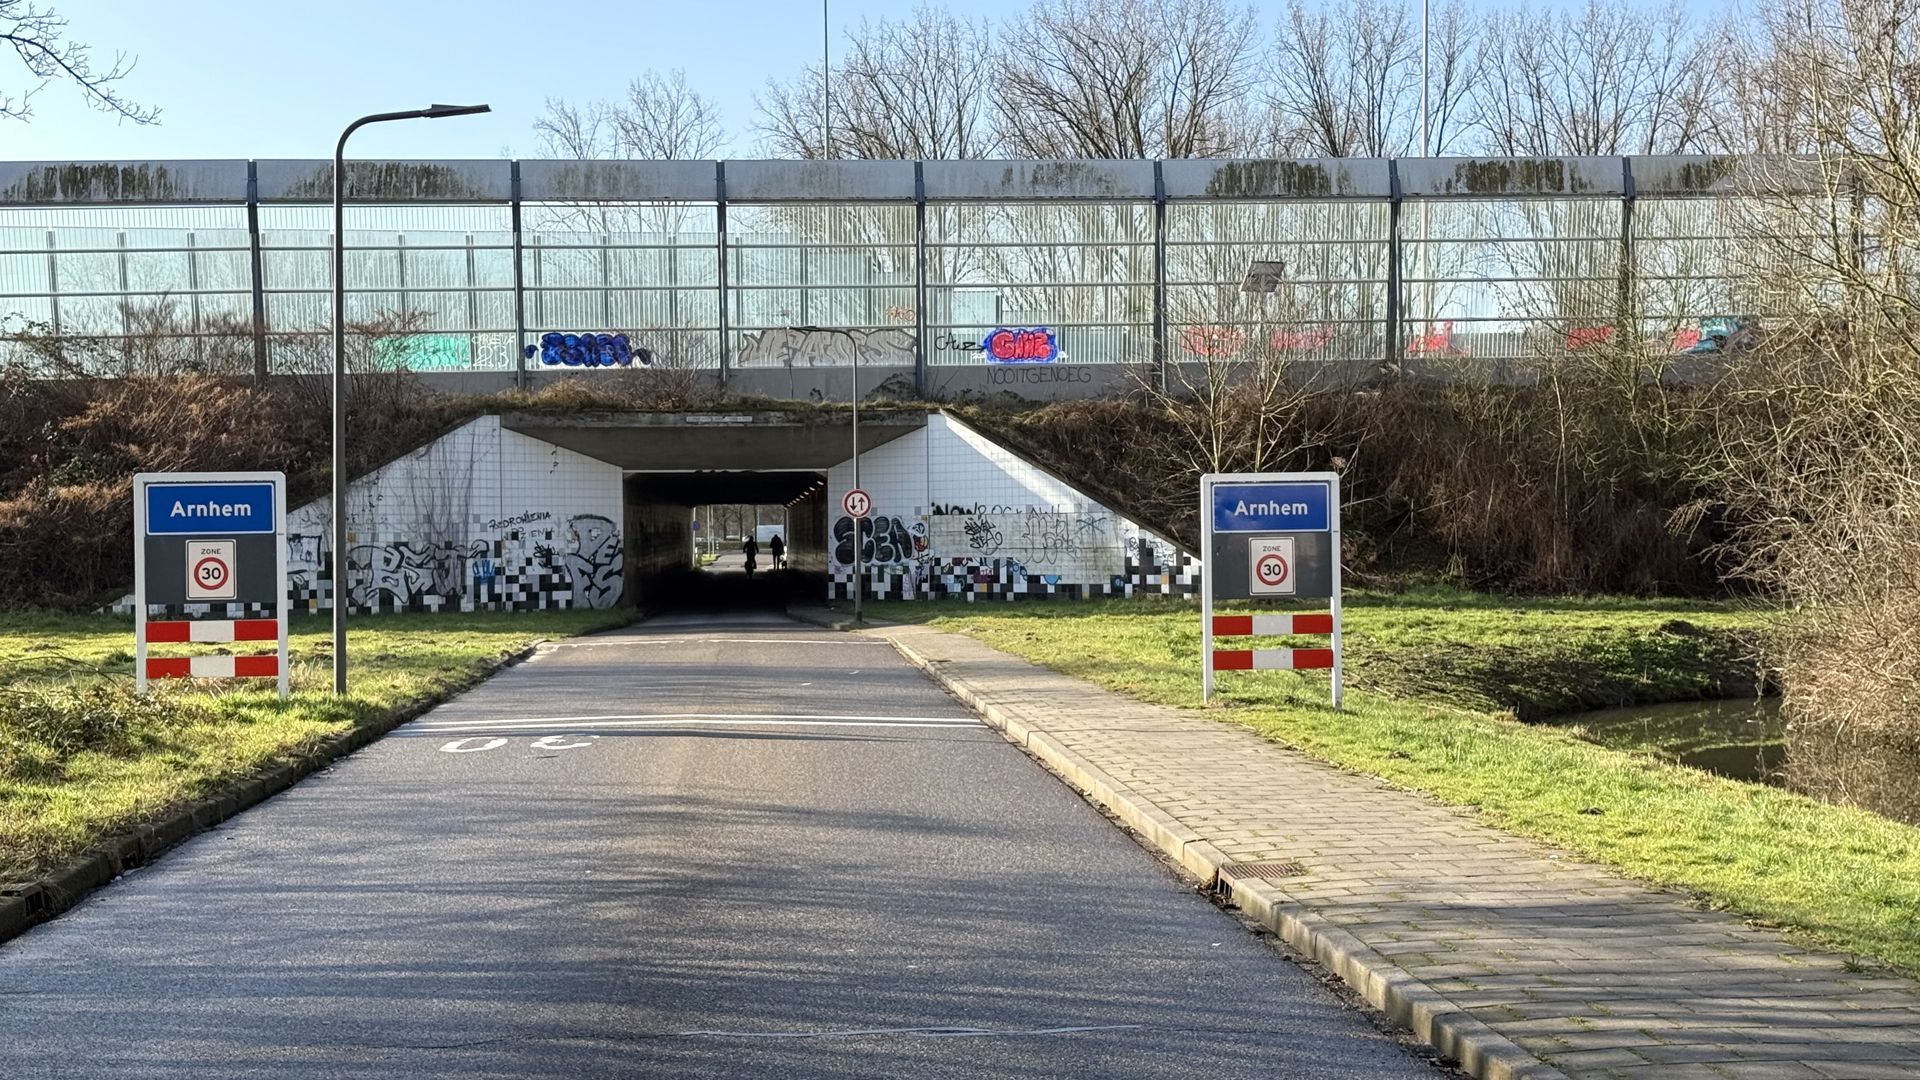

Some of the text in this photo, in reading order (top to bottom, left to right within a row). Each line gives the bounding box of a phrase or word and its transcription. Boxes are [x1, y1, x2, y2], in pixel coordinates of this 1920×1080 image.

[987, 367, 1092, 384] NOOITGENOEG
[170, 500, 252, 517] Arnhem
[1234, 500, 1308, 516] Arnhem
[201, 567, 222, 580] 30
[1263, 564, 1282, 576] 30
